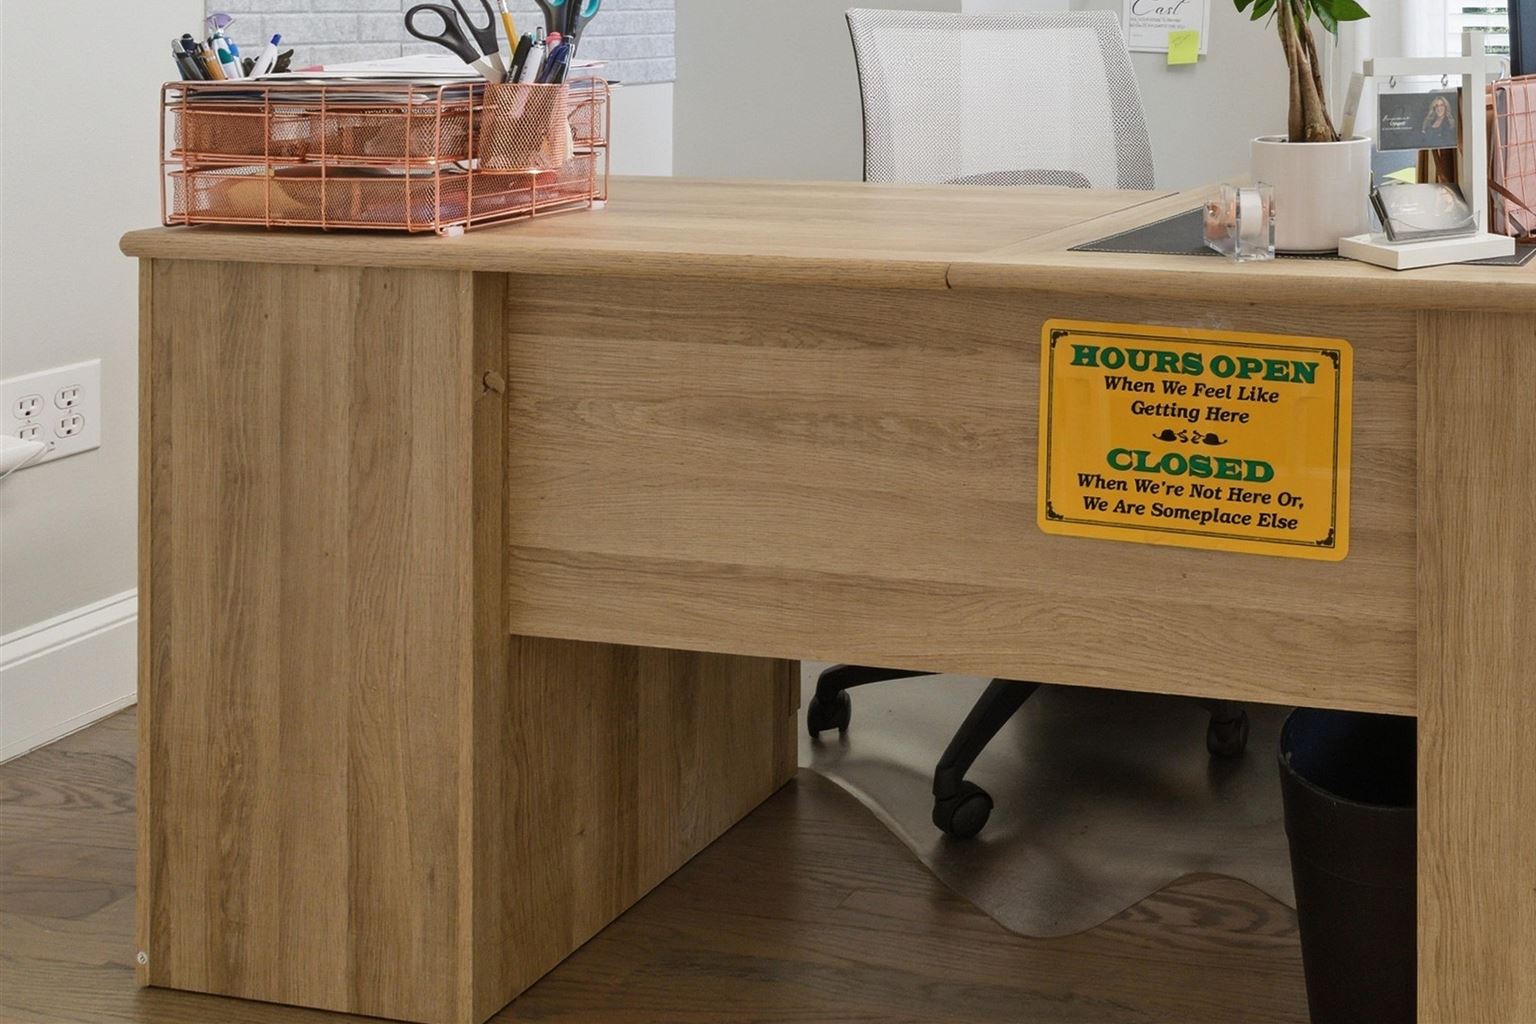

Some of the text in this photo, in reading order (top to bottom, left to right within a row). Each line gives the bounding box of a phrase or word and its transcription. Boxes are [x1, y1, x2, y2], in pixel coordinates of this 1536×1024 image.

[1070, 344, 1319, 384] HOURS OPEN
[1104, 376, 1279, 404] When We Feel Like
[1131, 400, 1250, 424] Getting Here
[1106, 447, 1275, 483] CLOSED
[1077, 473, 1305, 510] When We're Not Here Or,
[1083, 495, 1298, 530] We Are Someplace Else
